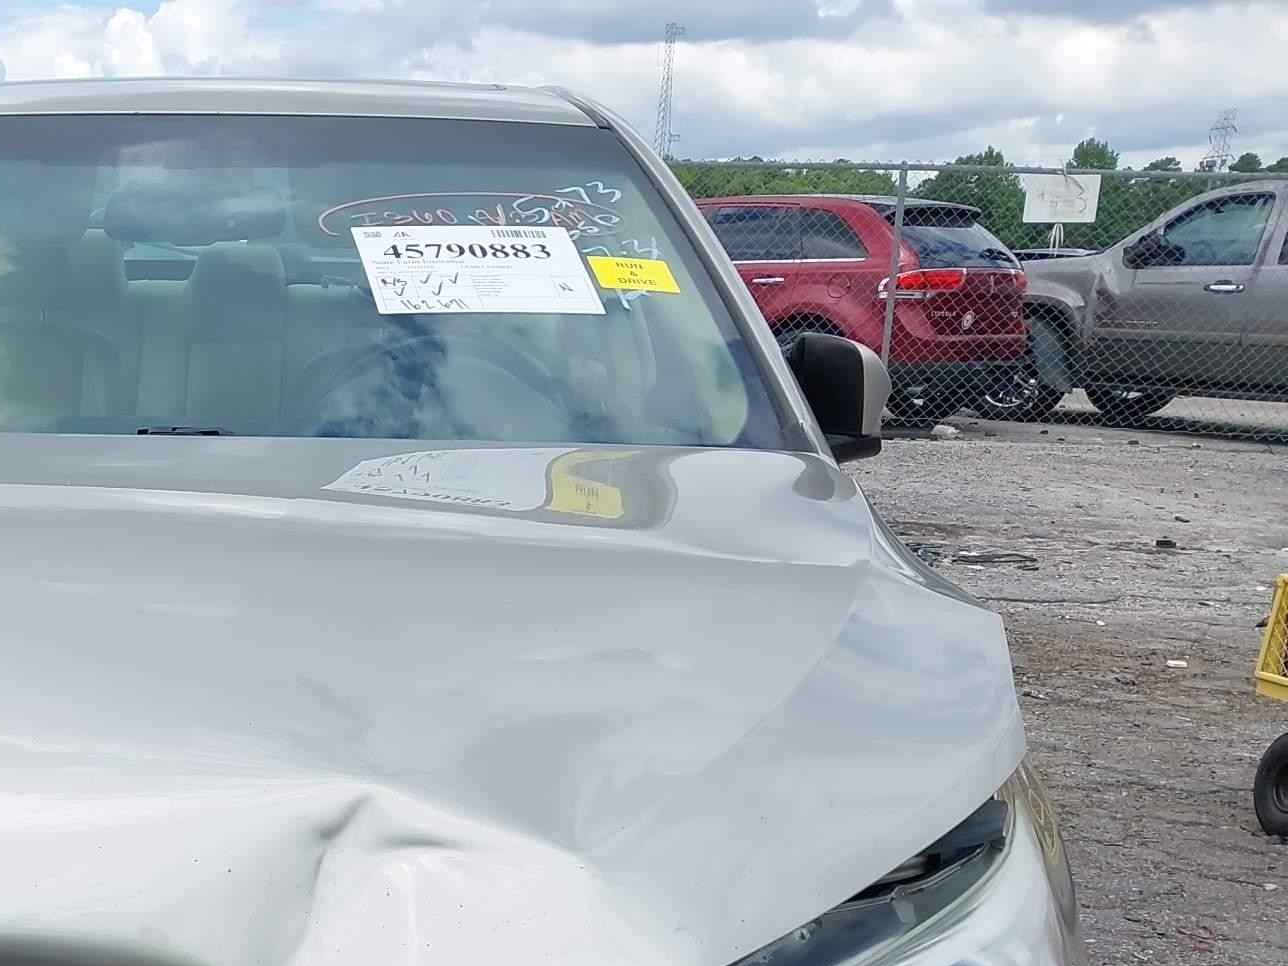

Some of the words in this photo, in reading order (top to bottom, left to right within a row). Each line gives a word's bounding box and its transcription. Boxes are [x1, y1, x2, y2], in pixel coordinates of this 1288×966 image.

[383, 243, 552, 259] 45790883
[615, 261, 643, 270] RUN
[617, 277, 657, 286] DRIVE
